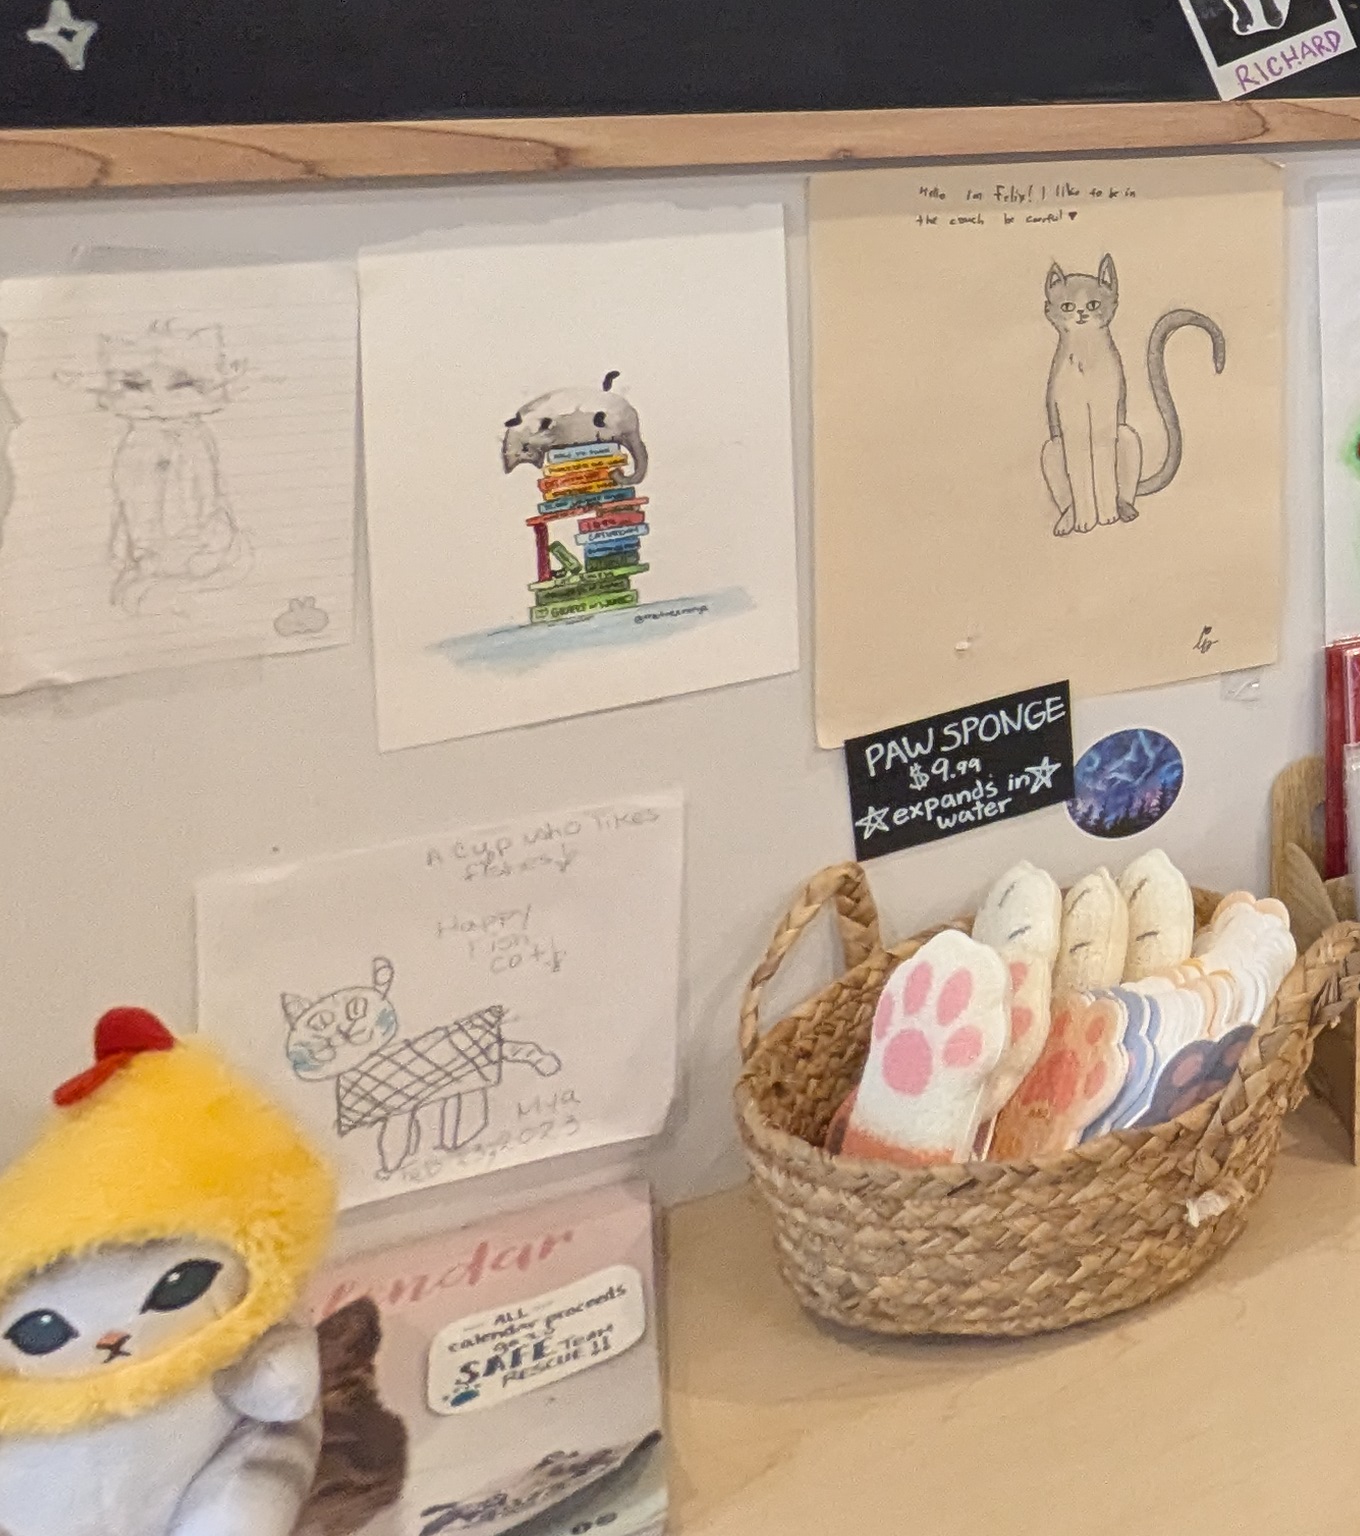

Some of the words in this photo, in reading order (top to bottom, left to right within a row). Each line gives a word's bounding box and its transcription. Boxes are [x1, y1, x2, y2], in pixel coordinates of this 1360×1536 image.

[1235, 27, 1343, 92] RICHARD
[918, 183, 946, 201] Hello
[1088, 185, 1103, 198] to
[1108, 187, 1119, 198] be
[1123, 187, 1137, 198] in
[915, 214, 938, 226] the
[1003, 213, 1015, 225] be
[865, 727, 935, 778] PAW
[940, 695, 1068, 753] SPONGE
[908, 756, 982, 792] $9.99
[892, 778, 999, 826] expands
[1007, 773, 1031, 792] in
[936, 797, 1013, 831] water
[454, 1337, 556, 1386] SAFE
